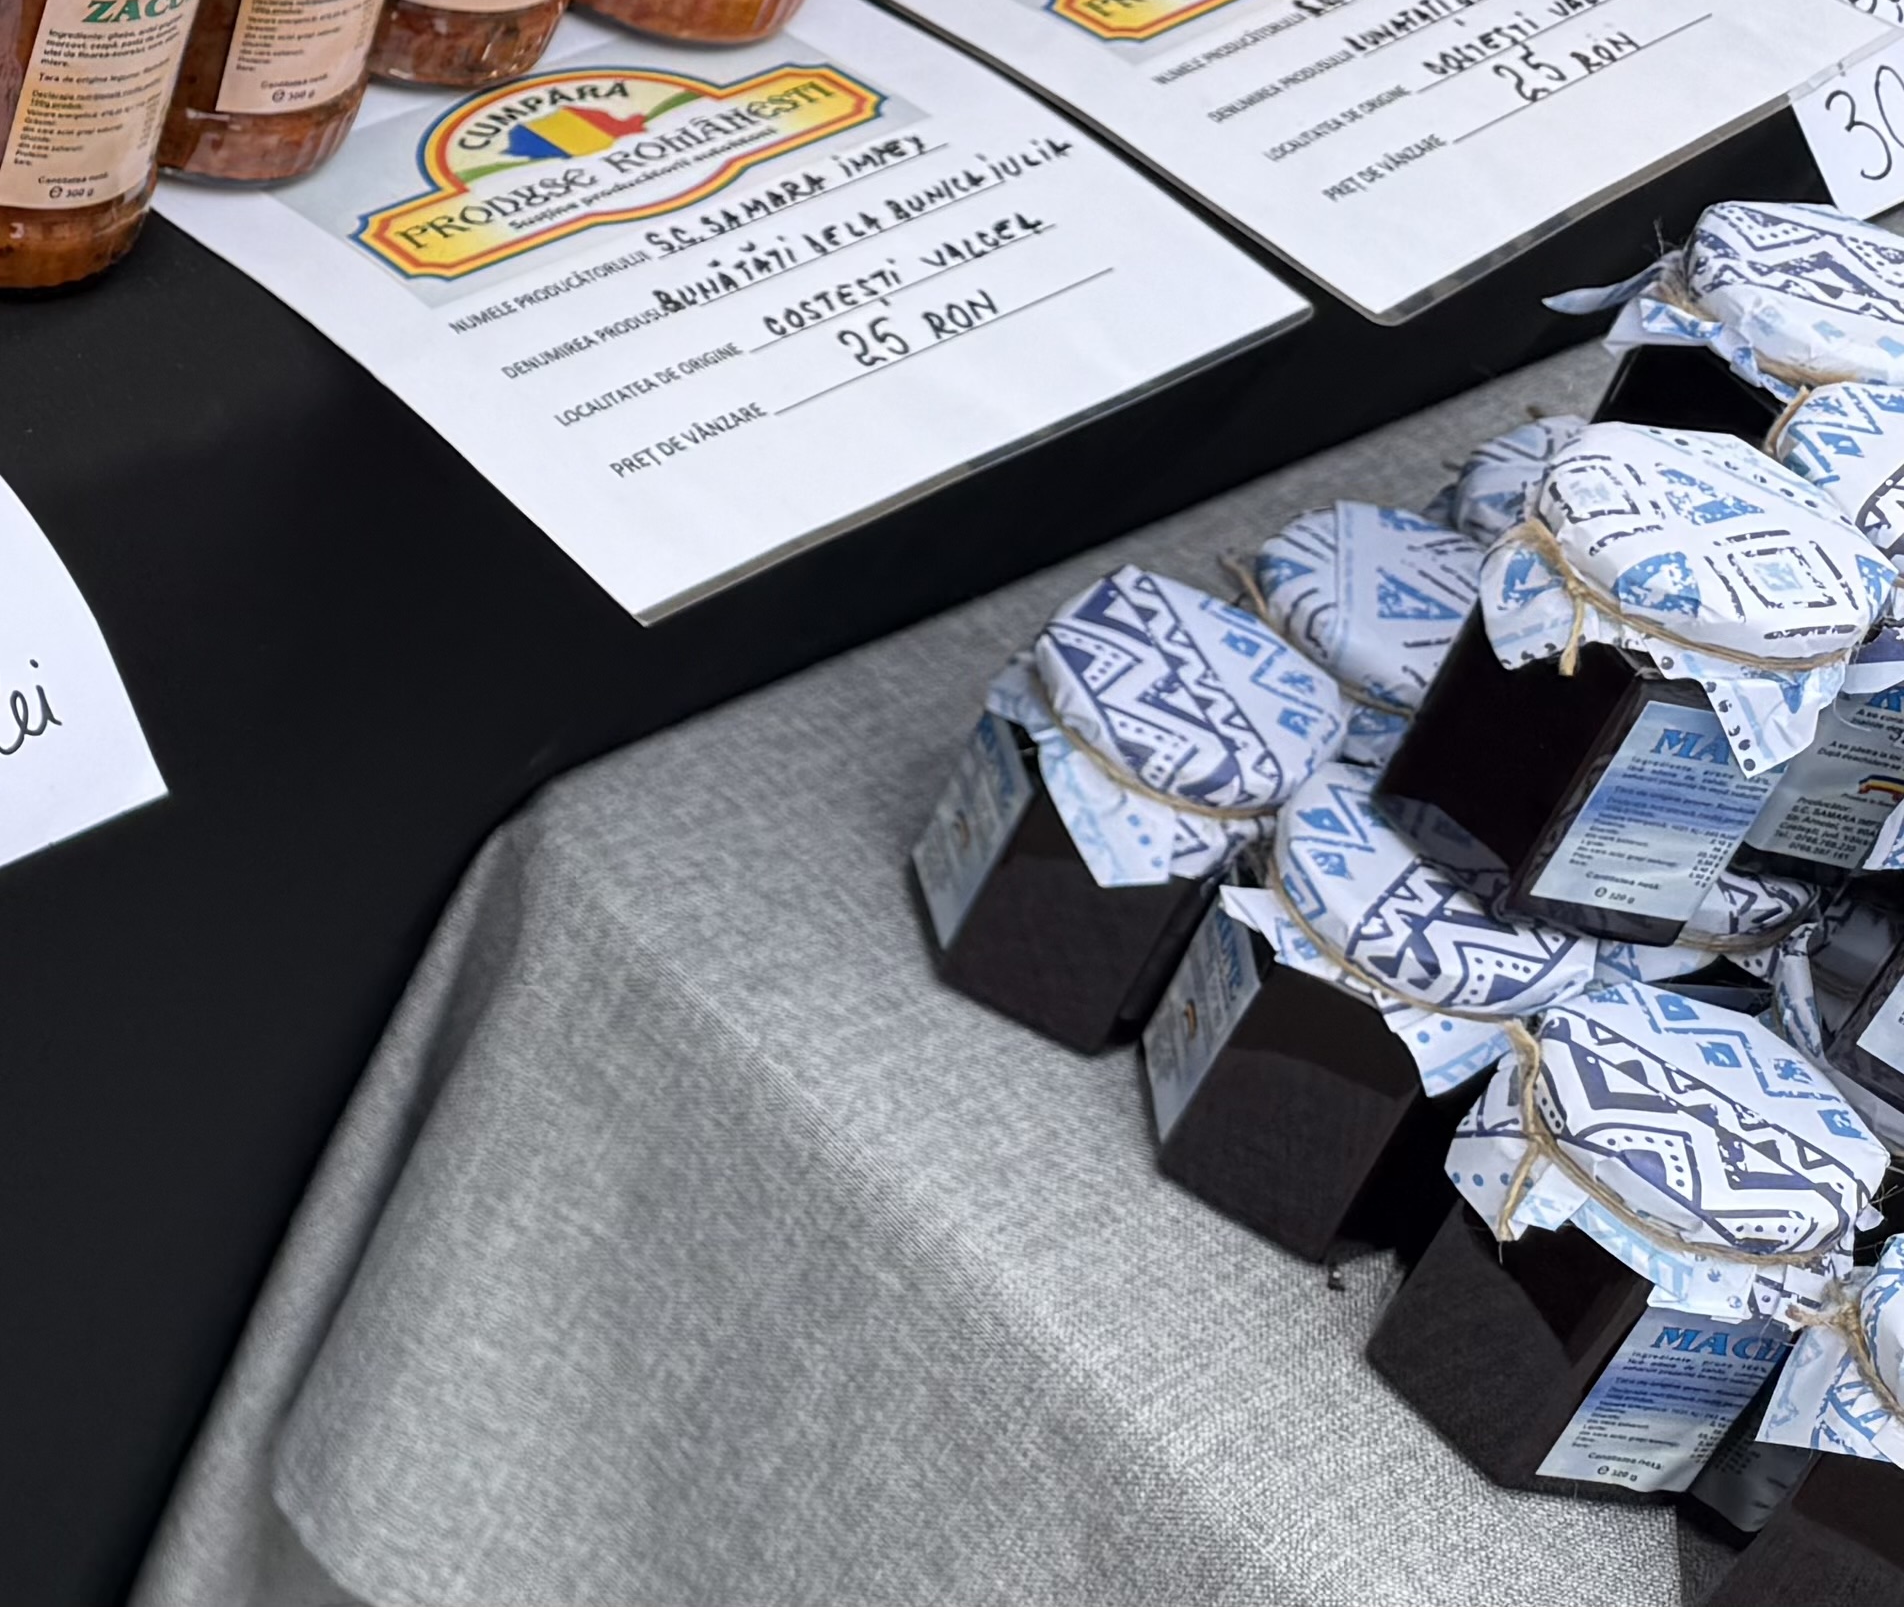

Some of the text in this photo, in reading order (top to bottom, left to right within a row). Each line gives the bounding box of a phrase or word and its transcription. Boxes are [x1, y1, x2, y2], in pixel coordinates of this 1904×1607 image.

[1570, 32, 1642, 74] RON
[396, 168, 597, 249] PRODUSE
[700, 172, 826, 235] SAMARA
[448, 249, 650, 334] NUMELE PRODUCĂTORULUI
[836, 289, 1000, 367] 25 RON
[501, 335, 598, 380] DENUMIREA
[554, 342, 744, 427] LOCALITATEA DE ORIGINE
[609, 402, 768, 478] PREȚ DE VÂNZARE
